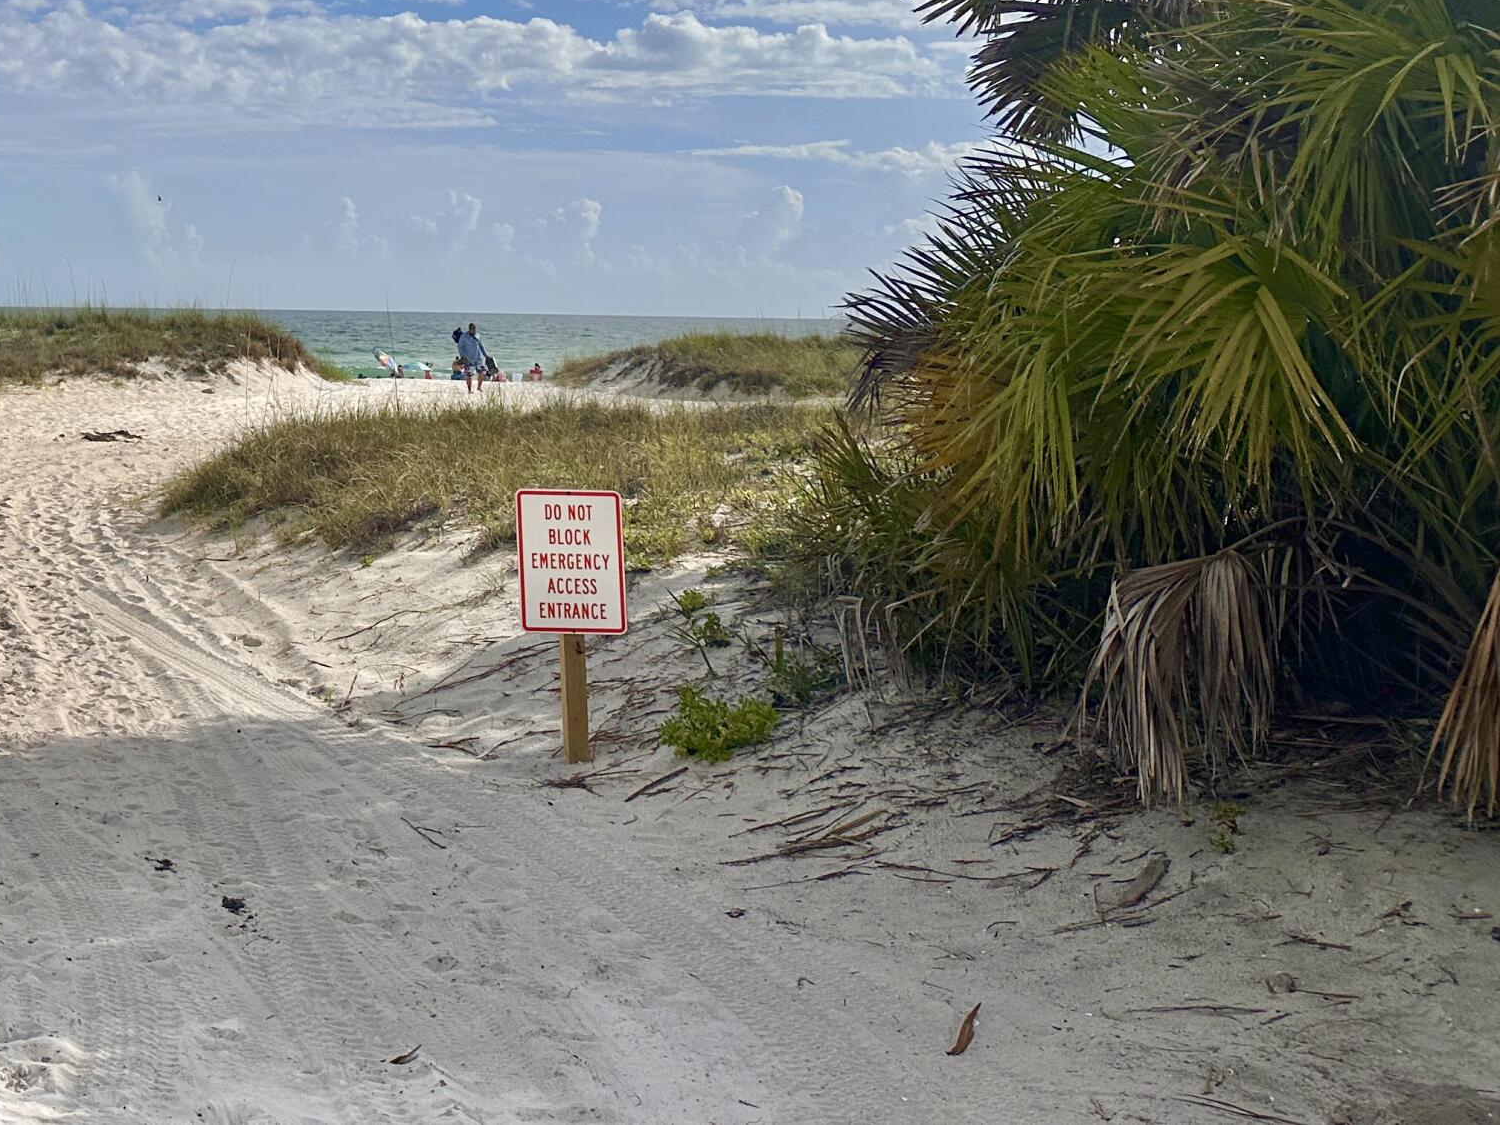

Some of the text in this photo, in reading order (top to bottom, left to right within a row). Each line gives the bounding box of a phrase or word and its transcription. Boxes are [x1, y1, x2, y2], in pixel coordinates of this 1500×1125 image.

[544, 504, 592, 521] DO NOT
[548, 528, 591, 546] BLOCK
[531, 553, 610, 570] EMERGENCY
[547, 578, 597, 595] ACCESS
[539, 602, 607, 620] ENTRANCE
